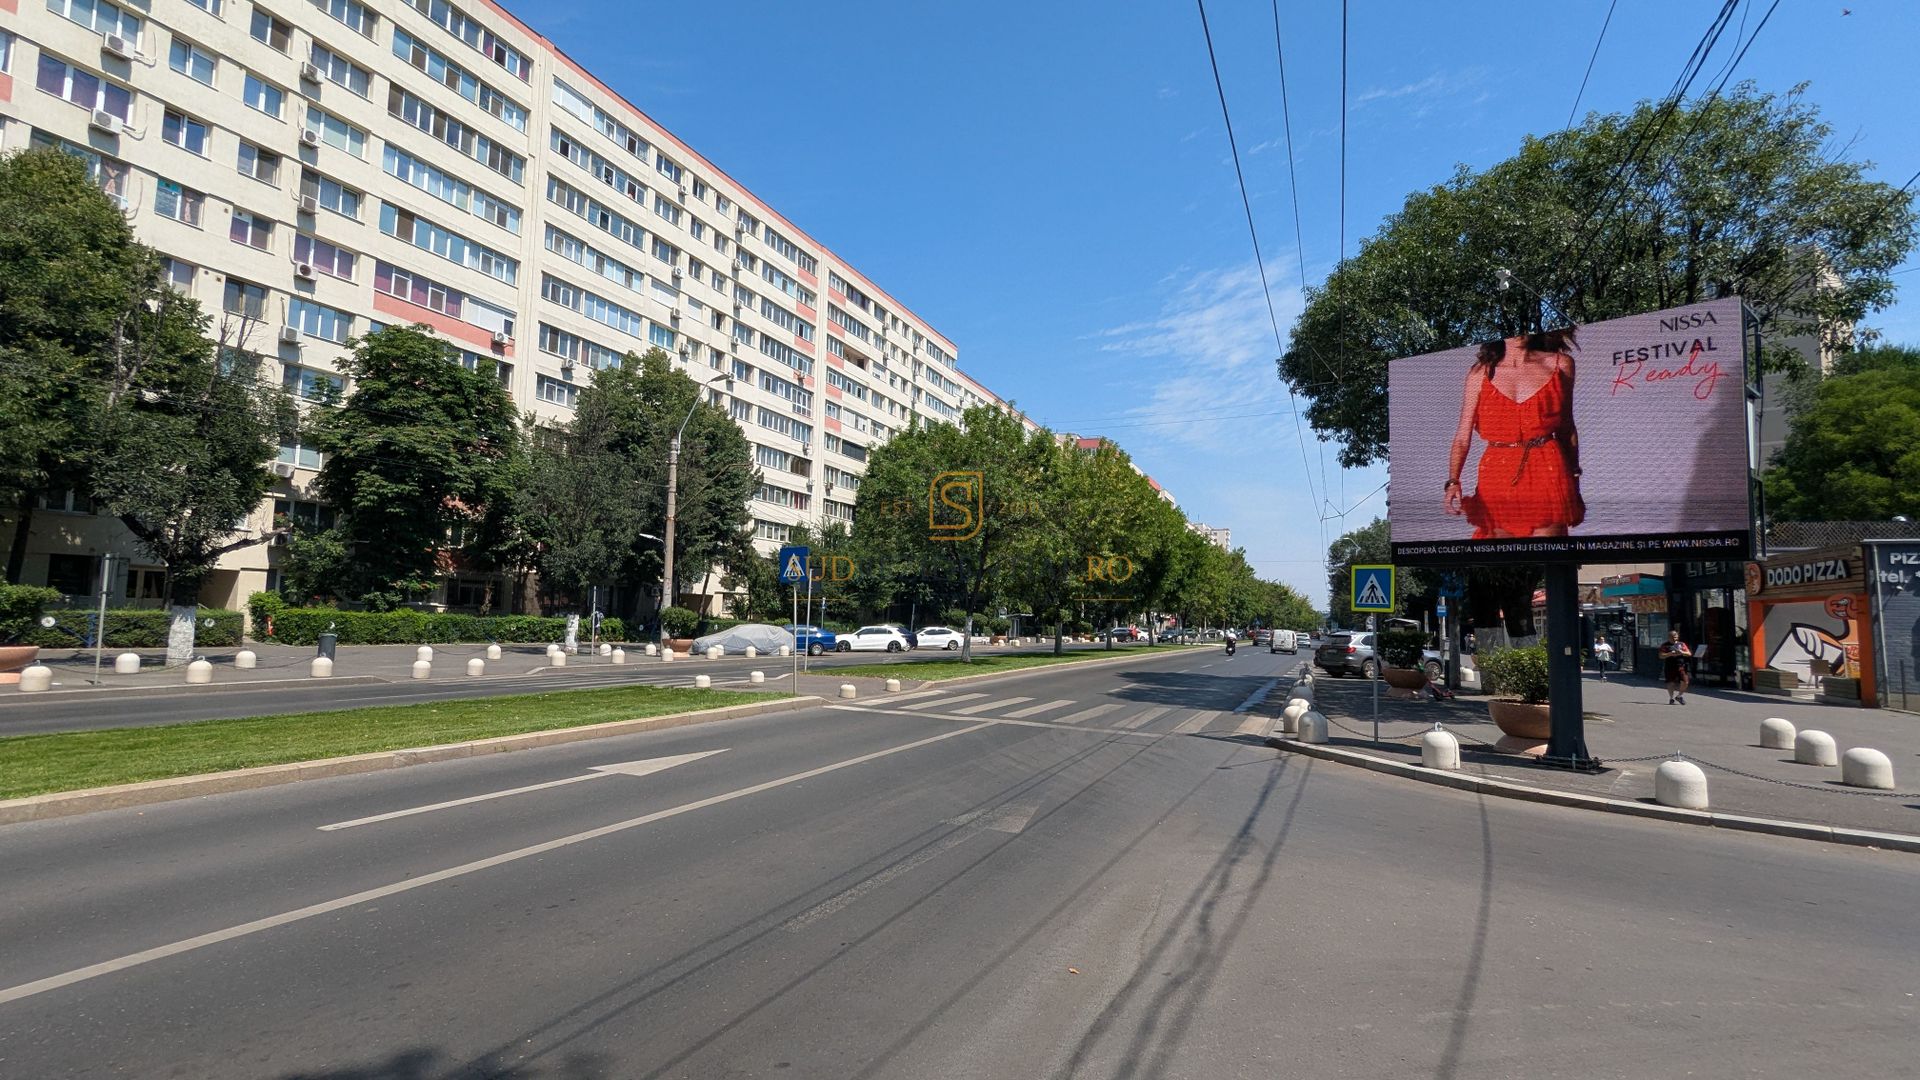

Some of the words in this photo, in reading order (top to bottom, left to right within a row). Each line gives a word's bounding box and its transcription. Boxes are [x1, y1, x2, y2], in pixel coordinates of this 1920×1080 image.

[1660, 311, 1717, 332] NISSA
[1612, 336, 1717, 365] FESTIVAL
[1611, 342, 1729, 400] Ready
[1473, 544, 1496, 553] NISSA
[1497, 544, 1527, 552] PENTRU
[1588, 541, 1635, 550] MAGAZINE
[1648, 541, 1660, 549] PE
[1663, 538, 1740, 548] WWW.NISSA.RO
[1767, 566, 1801, 586] DODO
[1804, 562, 1846, 583] PIZZA
